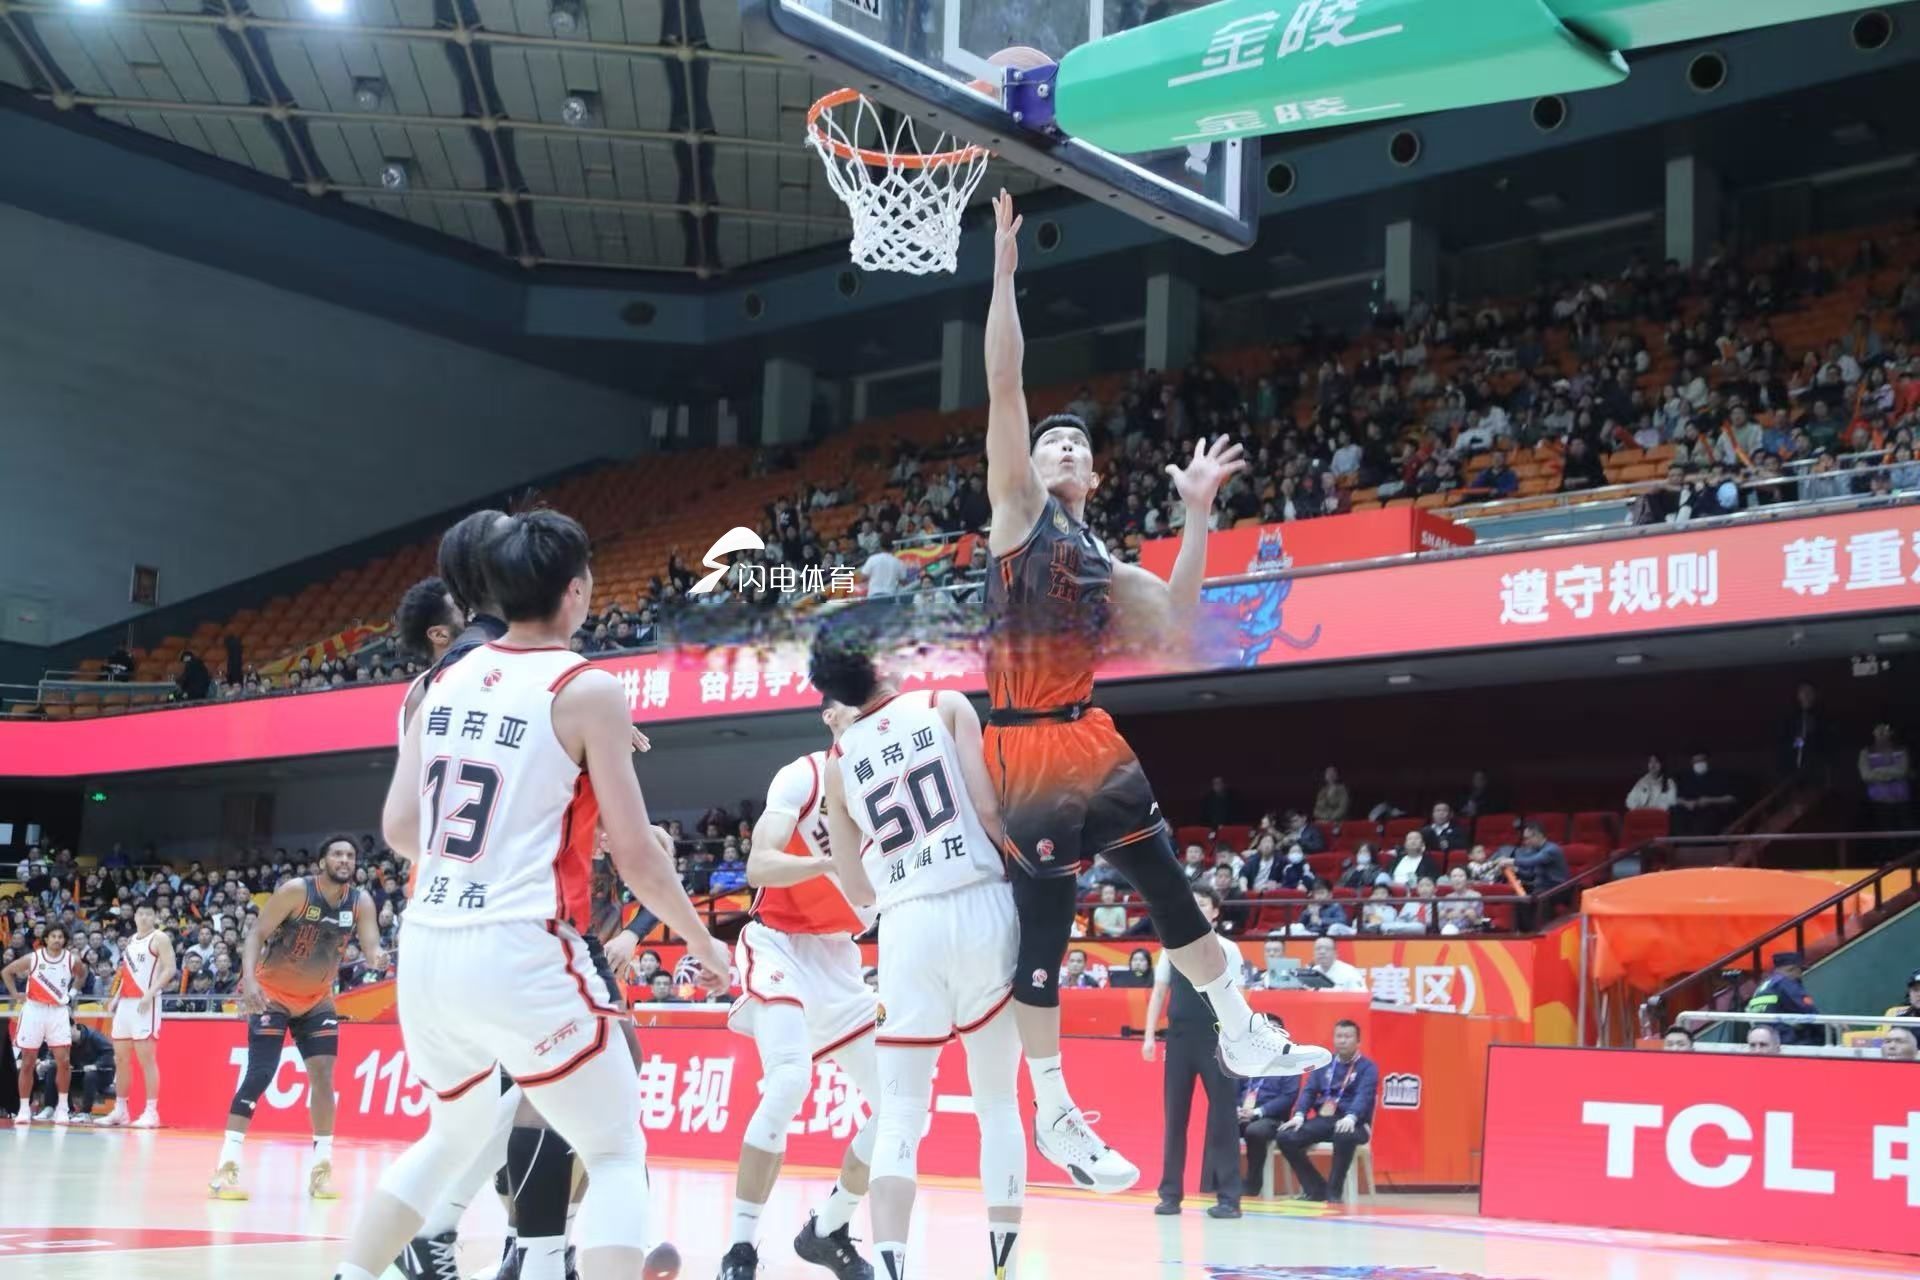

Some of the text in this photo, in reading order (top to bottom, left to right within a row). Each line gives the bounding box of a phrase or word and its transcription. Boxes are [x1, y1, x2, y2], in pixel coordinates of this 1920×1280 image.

[1499, 529, 1920, 624] 遵守规则 尊重
[426, 705, 528, 749] 肯帝亚
[854, 726, 935, 784] 肯帝亚
[422, 755, 504, 864] 13
[863, 755, 960, 858] 50
[1581, 1100, 1835, 1195] TCL
